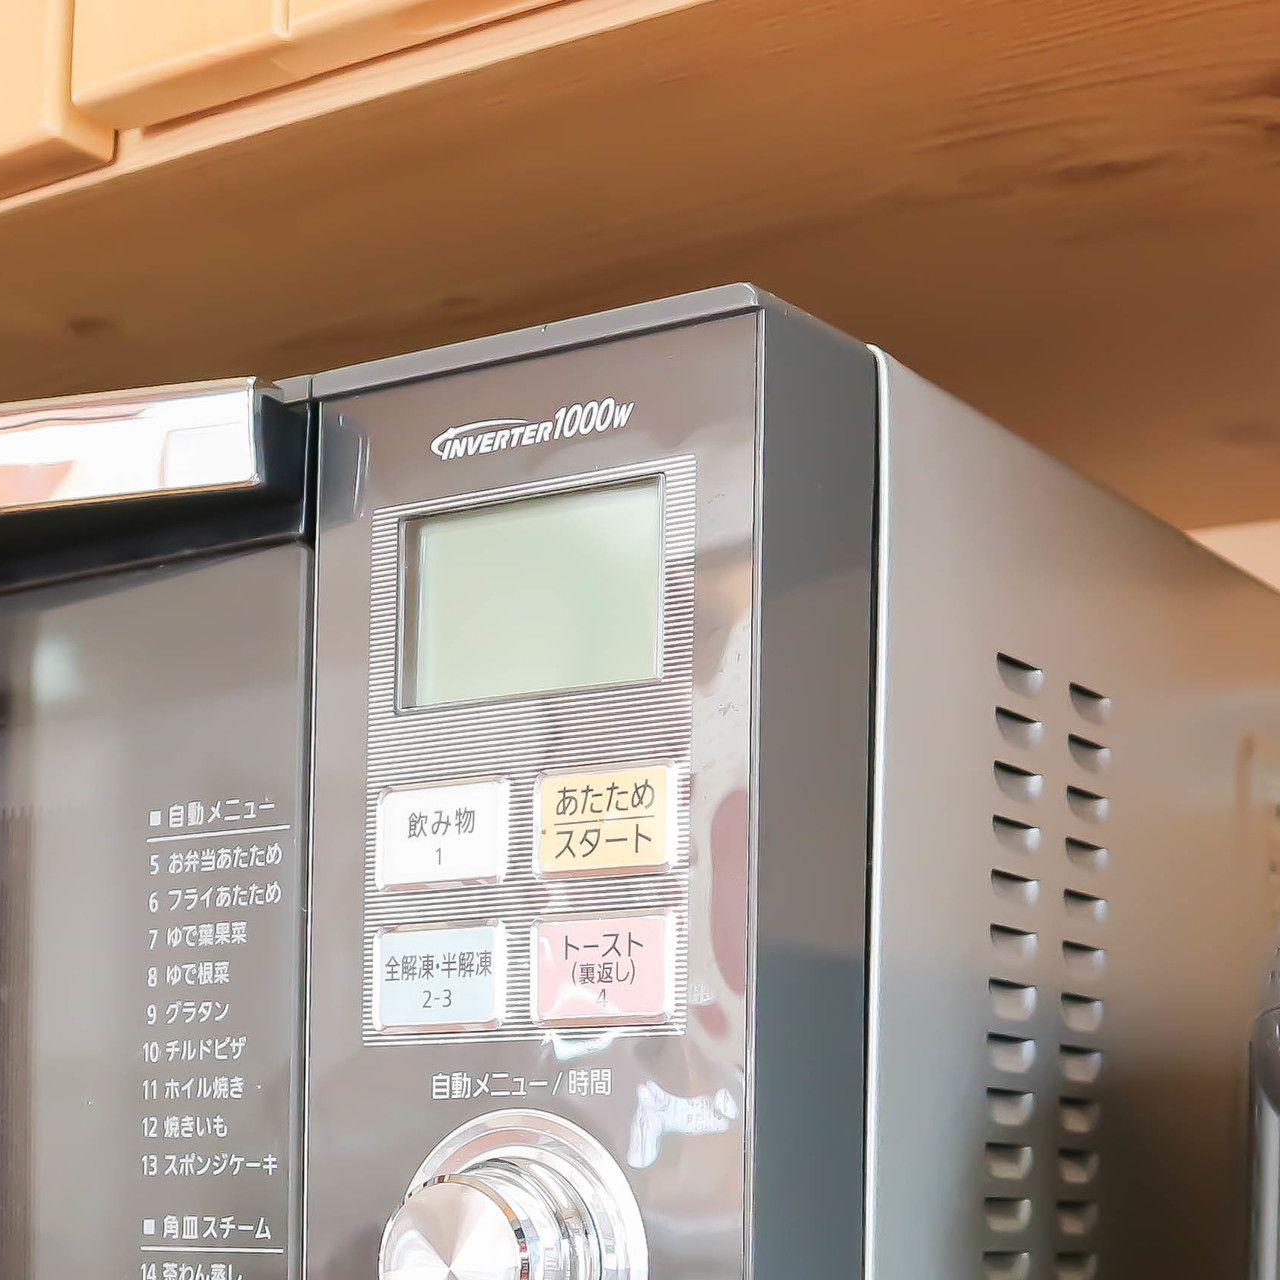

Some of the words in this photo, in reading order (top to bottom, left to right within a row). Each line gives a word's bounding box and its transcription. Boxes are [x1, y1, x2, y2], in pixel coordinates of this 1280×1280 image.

[555, 779, 655, 815] あたため
[169, 798, 275, 827] 自動メニュー
[408, 807, 475, 839] 飲み物
[555, 824, 652, 859] スタート
[150, 855, 159, 875] 5
[168, 843, 282, 874] お弁当あたため
[435, 848, 443, 865] 1
[149, 892, 158, 912] 6
[168, 881, 282, 911] フライあたため
[148, 929, 158, 949] 7
[167, 921, 247, 947] ゆで葉果菜
[564, 931, 644, 961] トースト
[147, 967, 157, 987] 8
[166, 961, 230, 986] ゆで根菜
[422, 989, 453, 1008] 2-3
[147, 1004, 156, 1025] 9
[166, 1002, 229, 1023] グラタン
[143, 1042, 159, 1063] 10
[165, 1037, 247, 1061] チルドピザ
[143, 1079, 157, 1100] 11
[164, 1076, 244, 1099] ホイル焼き
[142, 1116, 157, 1137] 12
[164, 1115, 228, 1138] 焼きいも
[142, 1154, 157, 1176] 13
[164, 1153, 278, 1176] スポンジケーキ
[163, 1215, 271, 1239] 角皿スチーム
